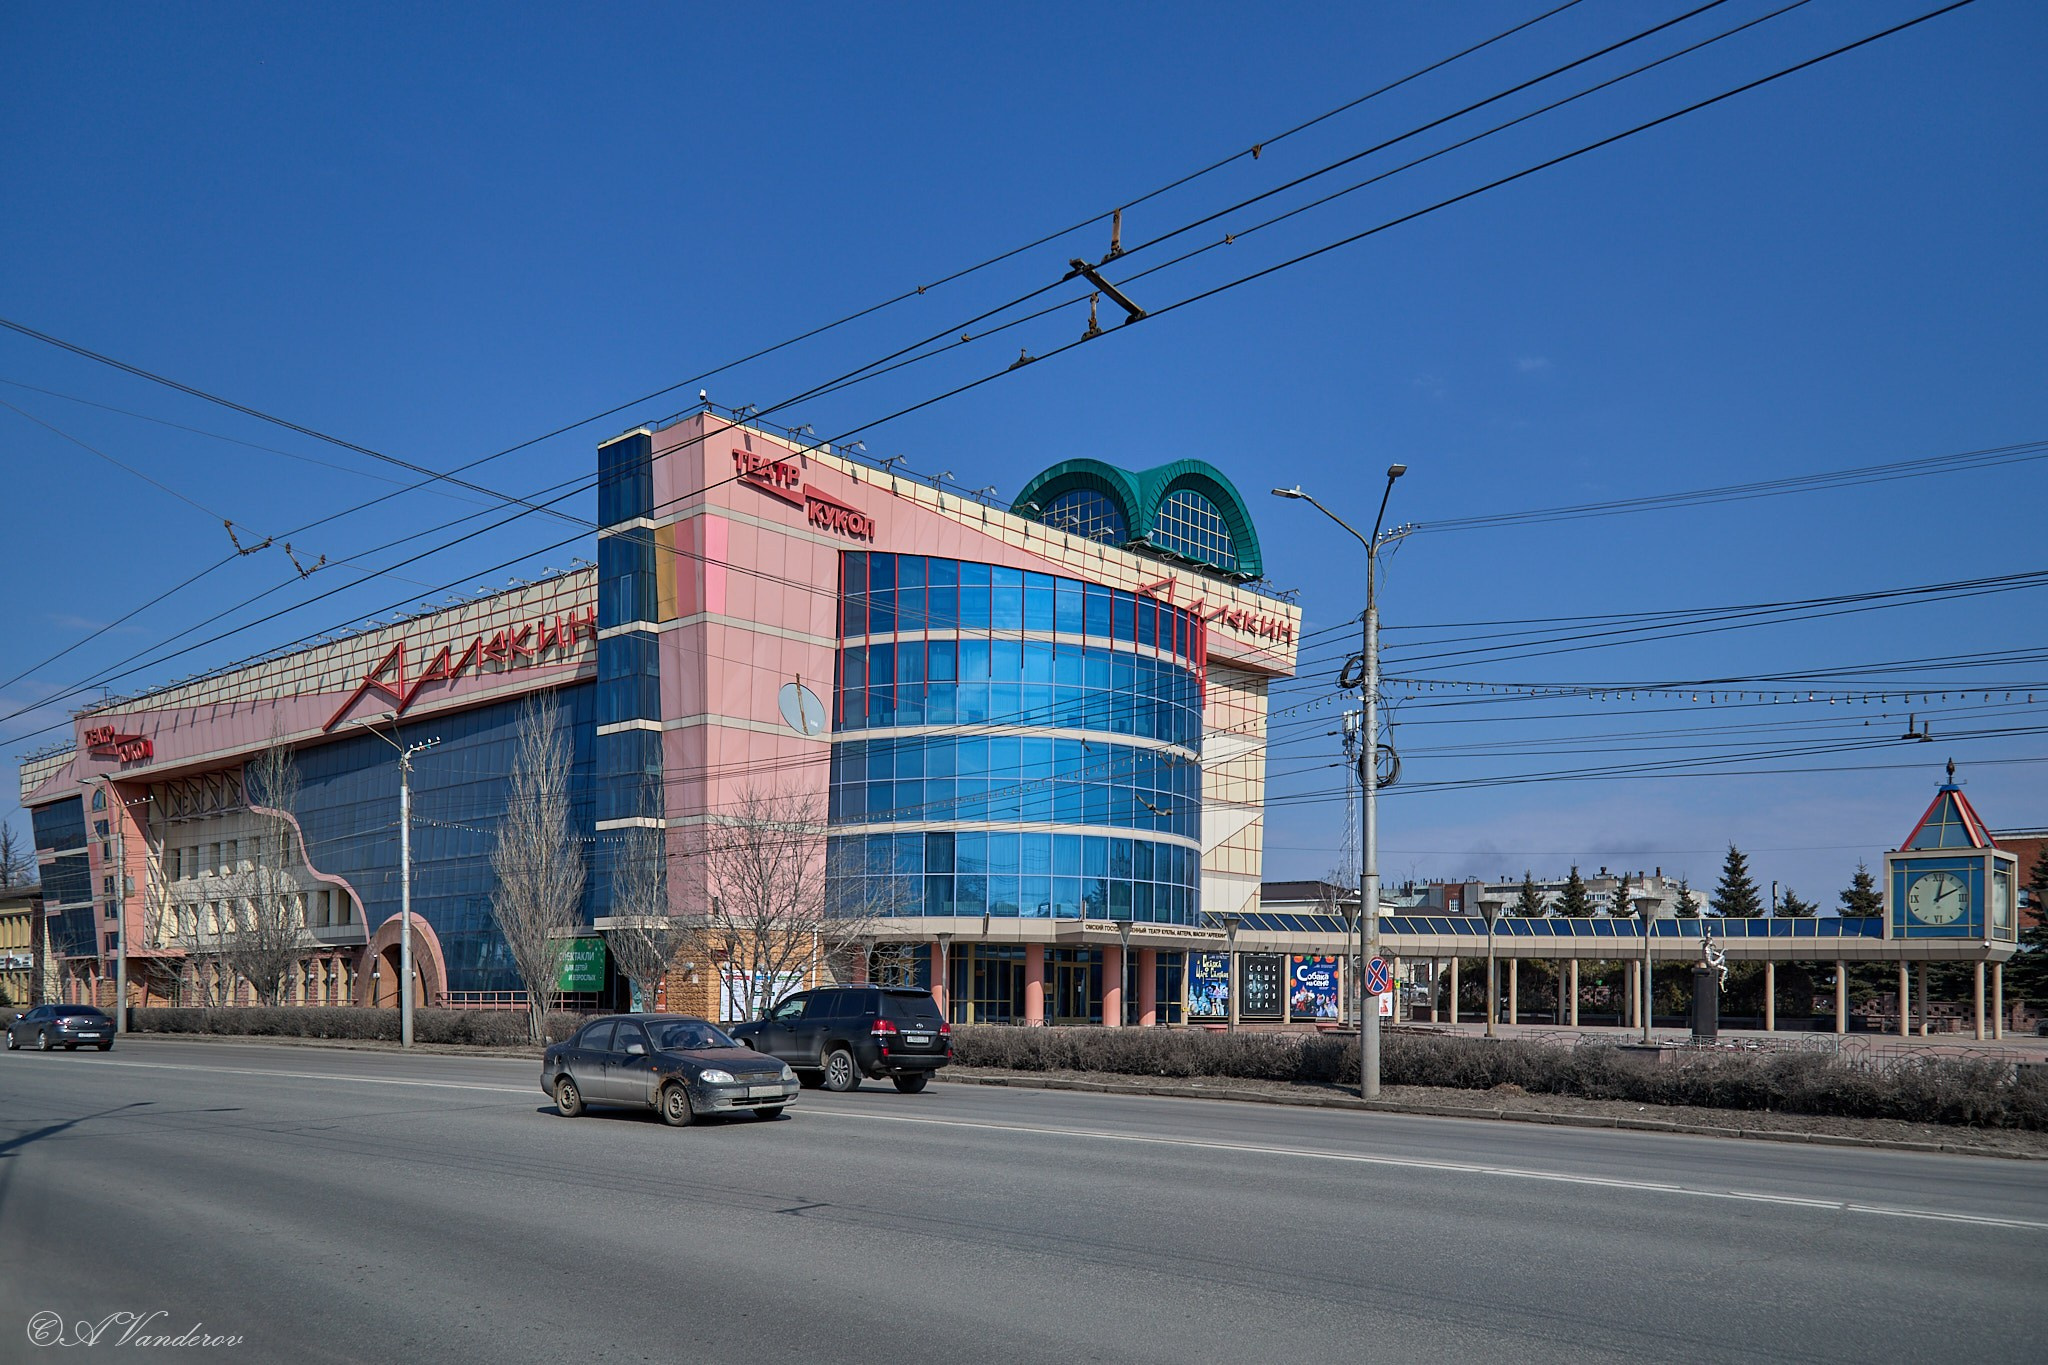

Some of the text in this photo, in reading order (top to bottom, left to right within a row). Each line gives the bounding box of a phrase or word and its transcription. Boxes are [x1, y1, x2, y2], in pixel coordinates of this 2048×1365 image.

[732, 448, 801, 485] ТЕАТР
[807, 500, 876, 539] КУКОЛ
[84, 725, 115, 747] ТЕАТР
[118, 740, 154, 763] КУКОЛ
[1910, 894, 1968, 904] IX III
[1085, 923, 1104, 931] ОМСКИЙ
[1934, 915, 1943, 923] VI
[1296, 965, 1330, 982] Собака
